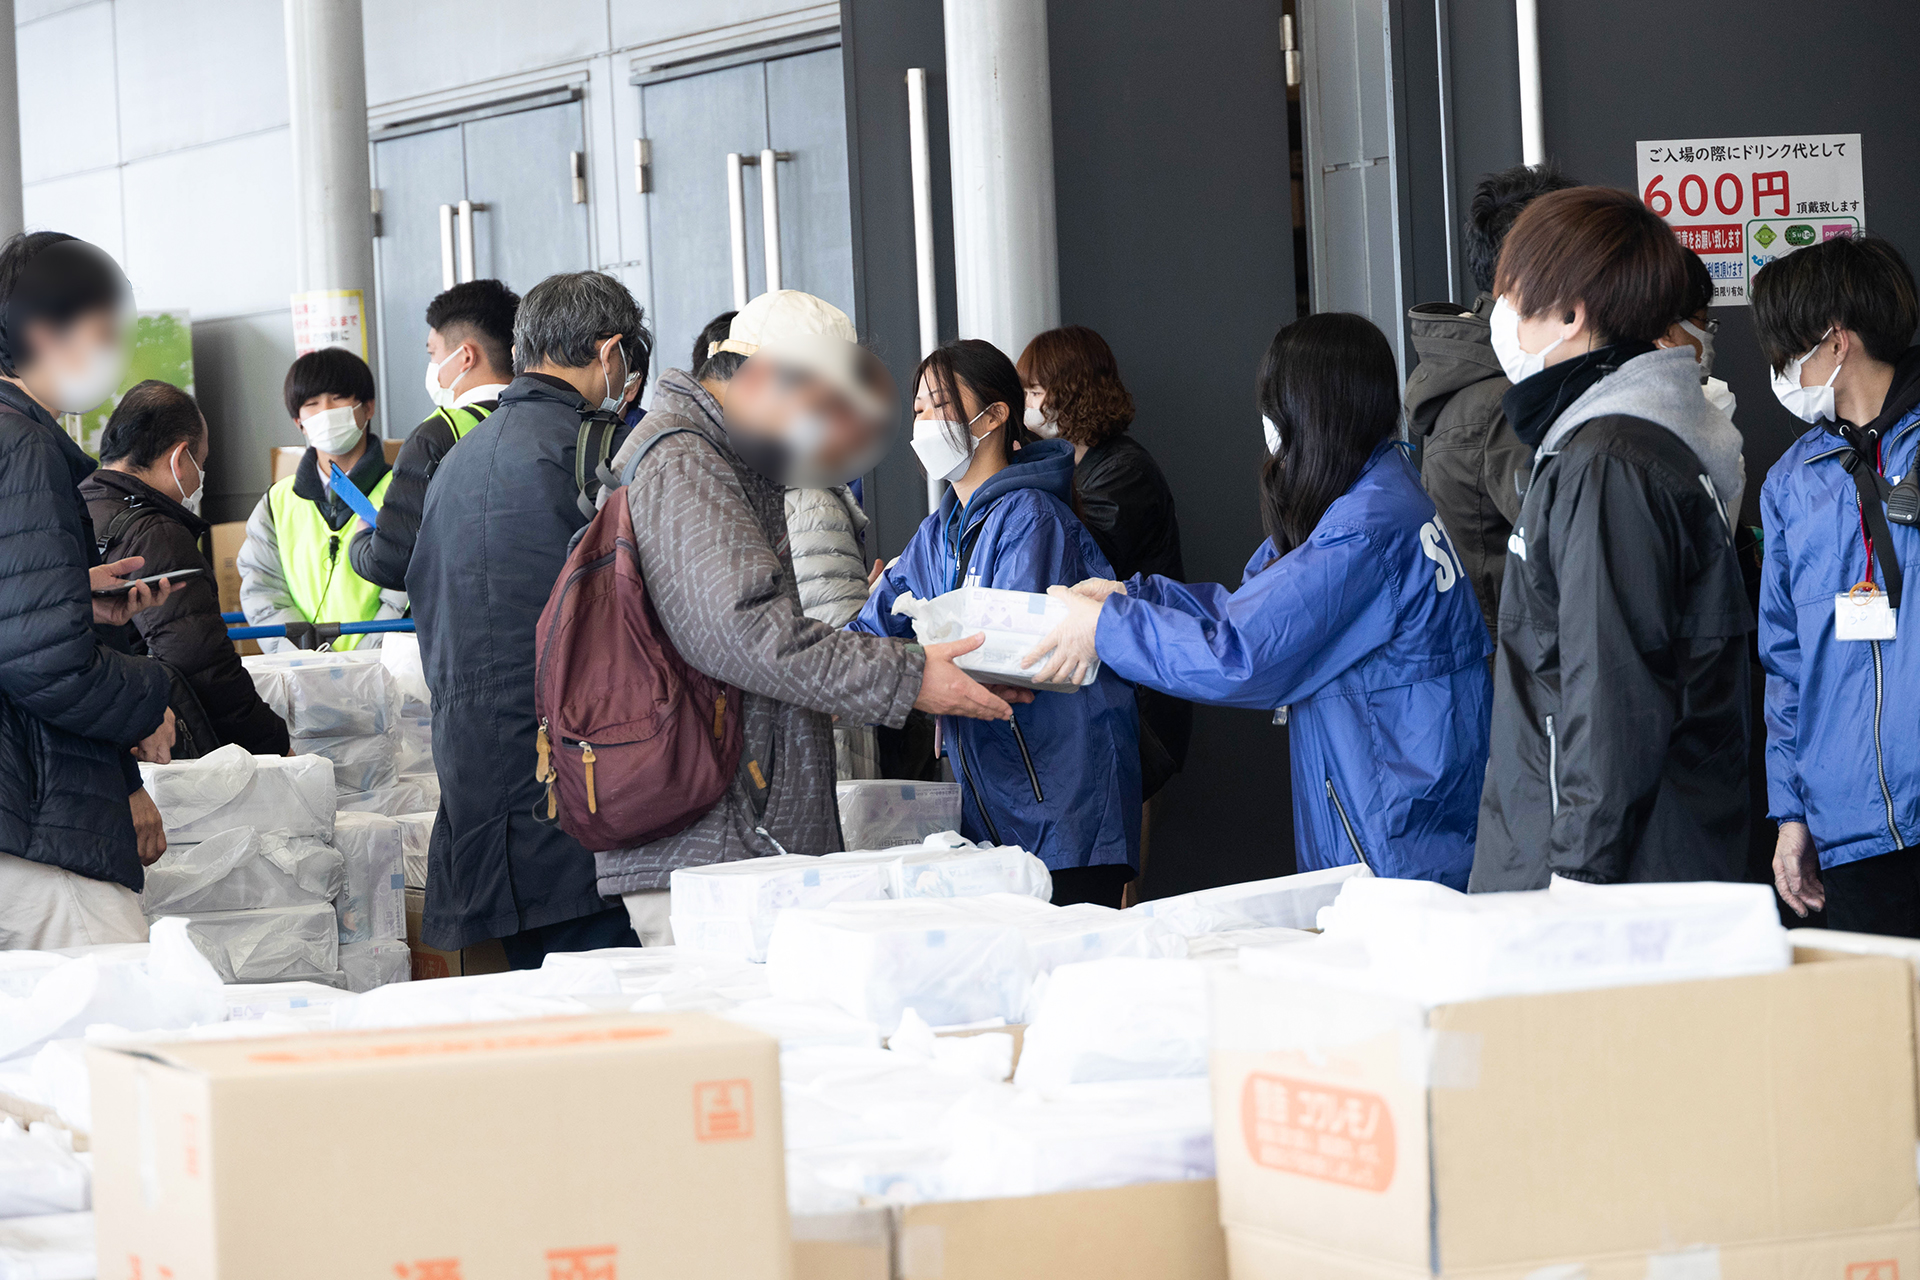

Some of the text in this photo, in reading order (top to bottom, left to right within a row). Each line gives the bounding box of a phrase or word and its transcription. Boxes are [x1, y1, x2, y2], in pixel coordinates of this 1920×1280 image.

[1650, 143, 1846, 163] ご入場の際にドリンク代として
[1644, 170, 1860, 217] 600円 頂戴致します
[1705, 261, 1743, 277] 利用頂けます
